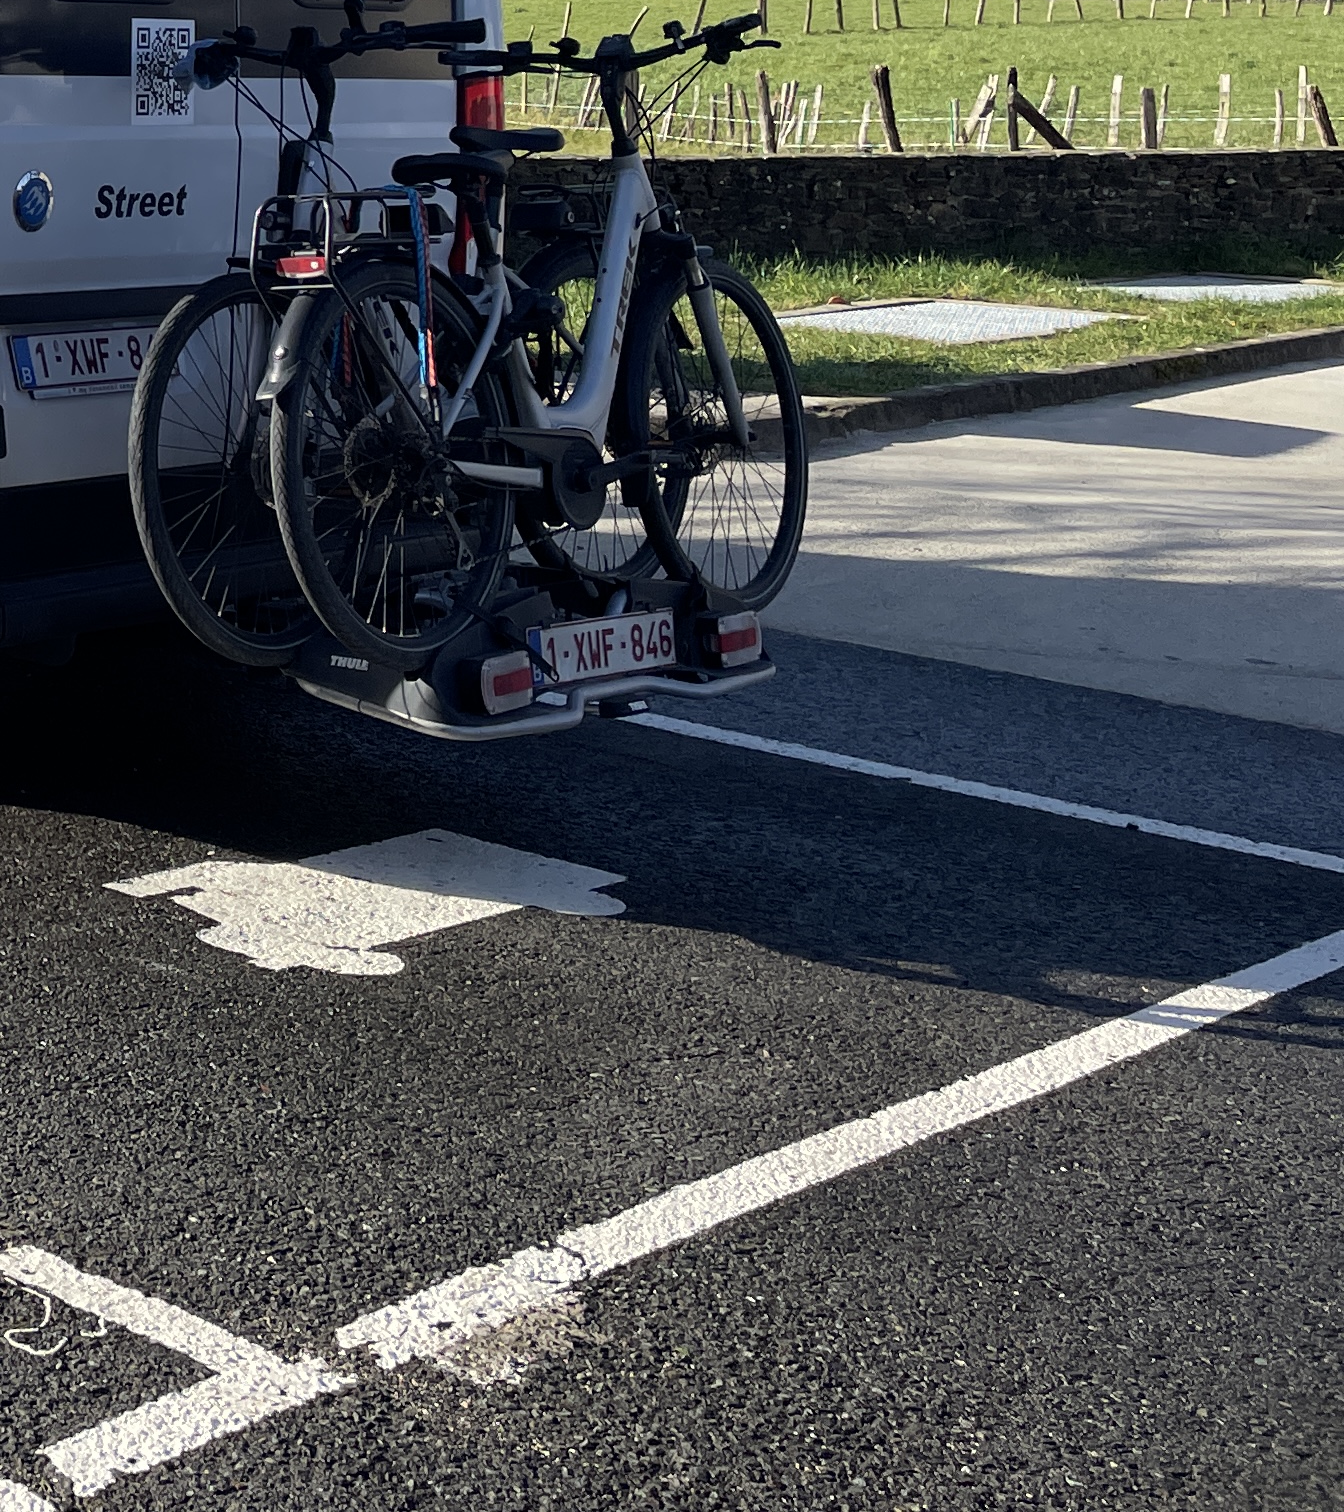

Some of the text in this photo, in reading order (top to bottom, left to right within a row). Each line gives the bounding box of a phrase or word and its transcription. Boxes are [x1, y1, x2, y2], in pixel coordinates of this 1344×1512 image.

[94, 184, 187, 219] Street
[610, 236, 638, 358] TREK
[21, 367, 33, 384] B
[330, 655, 369, 671] THULE
